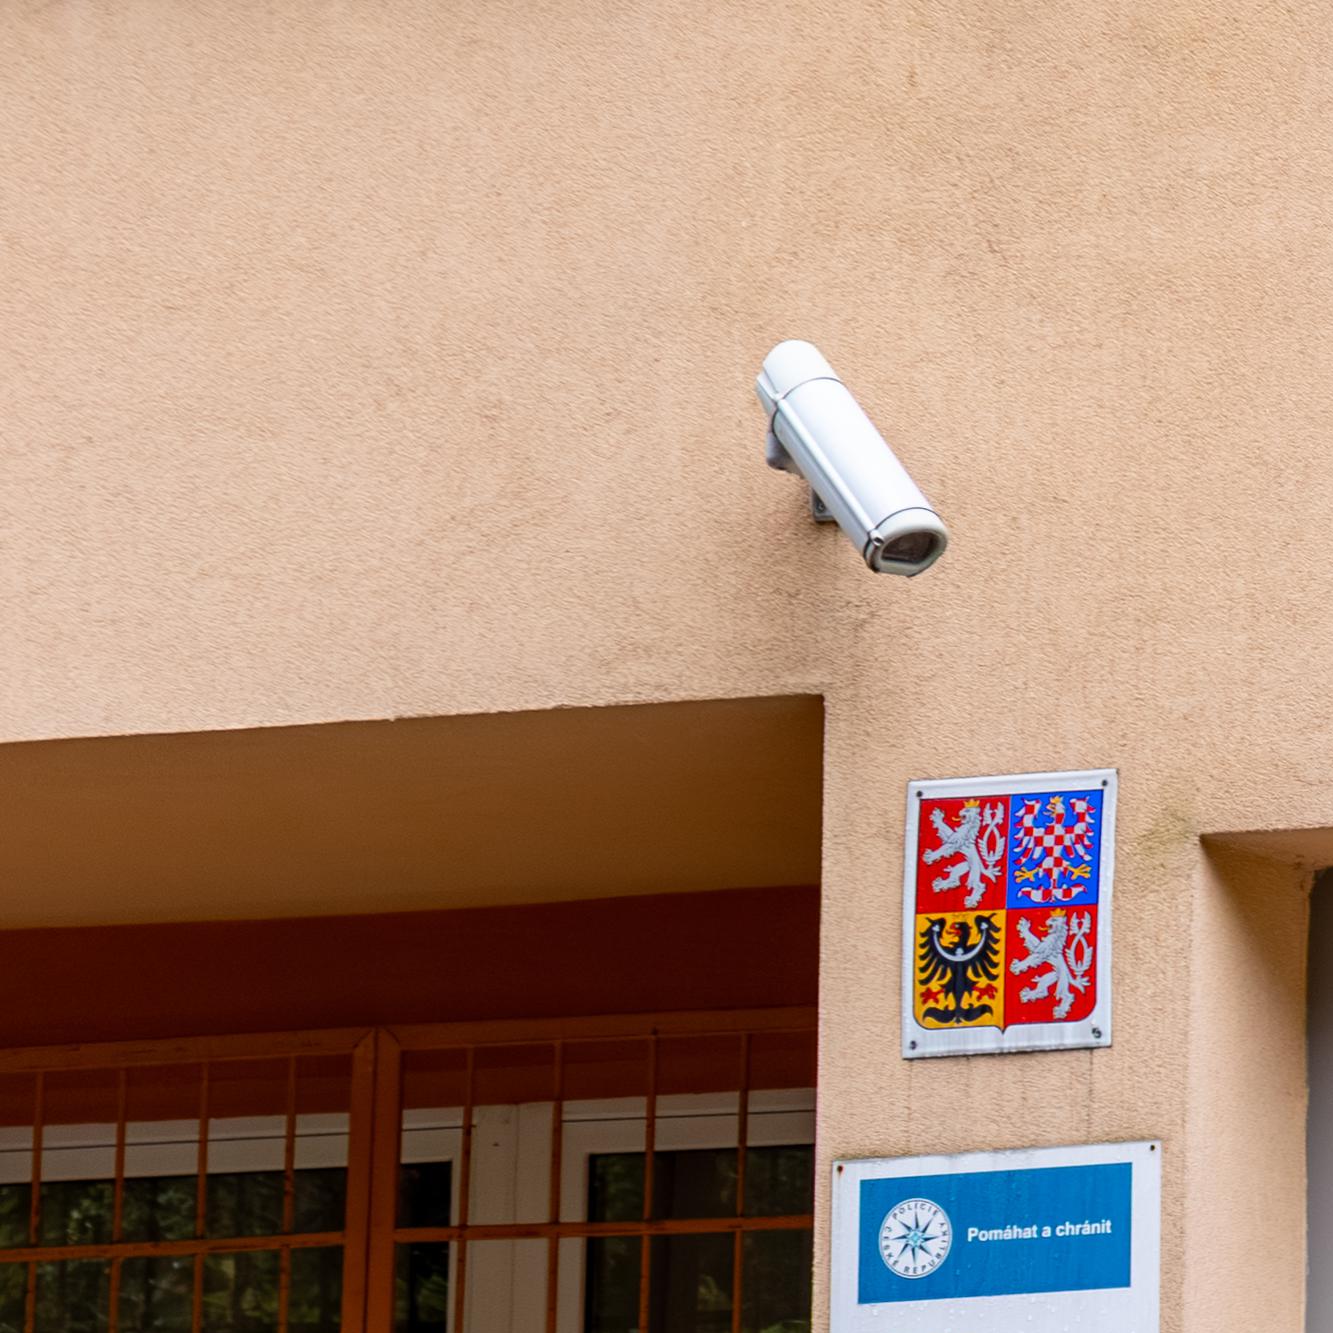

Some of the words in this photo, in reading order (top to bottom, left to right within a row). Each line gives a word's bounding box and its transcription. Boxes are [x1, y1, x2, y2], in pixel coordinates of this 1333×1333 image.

[967, 1223, 1037, 1242] Pomáhat
[1042, 1225, 1051, 1239] a
[1055, 1218, 1112, 1238] chránit
